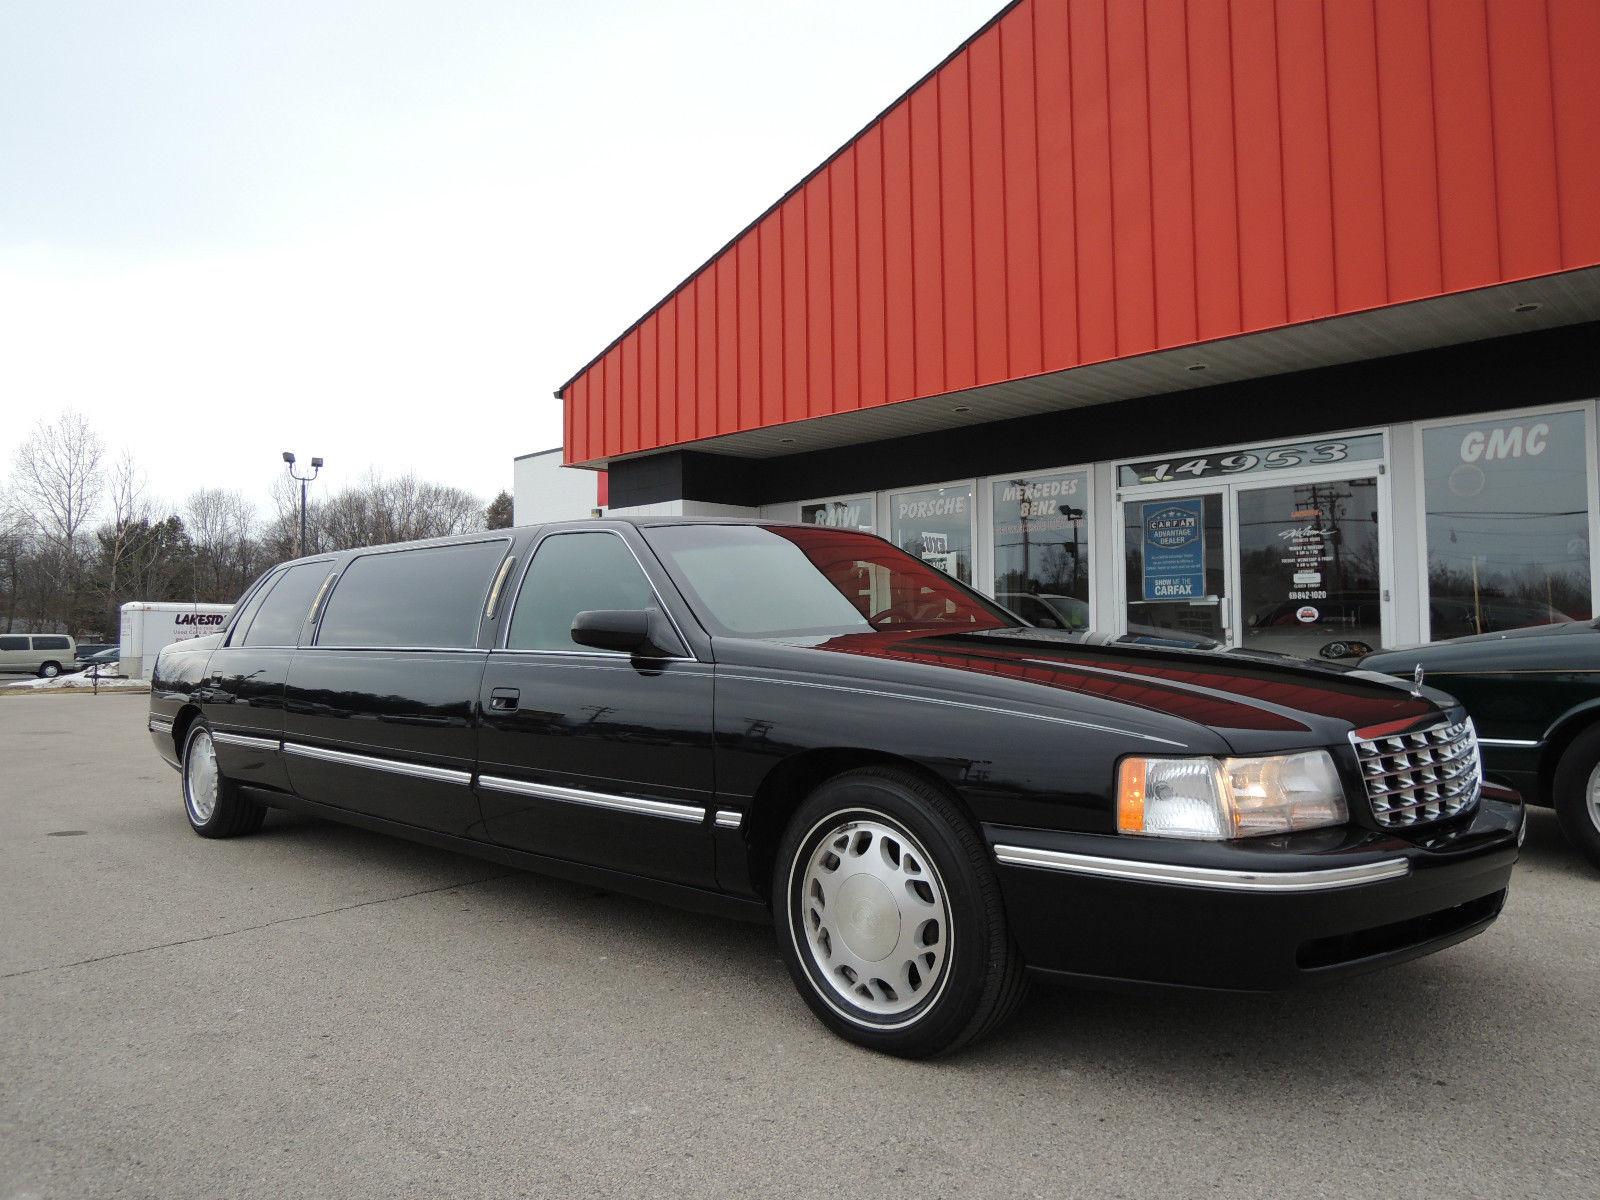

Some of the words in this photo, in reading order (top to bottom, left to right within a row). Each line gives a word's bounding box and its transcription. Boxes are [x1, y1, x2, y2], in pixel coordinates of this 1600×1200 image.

[1460, 423, 1549, 462] GMC
[1152, 442, 1349, 482] 14953
[1002, 480, 1079, 502] MERCEDES
[898, 496, 966, 520] PORSCHE
[1020, 499, 1057, 518] BENZ
[1150, 518, 1195, 529] CARFAX
[1153, 529, 1192, 538] ADVANTAGE
[1160, 536, 1185, 545] DEALER
[1154, 584, 1193, 596] CARFAX
[175, 613, 227, 626] LAKESID
